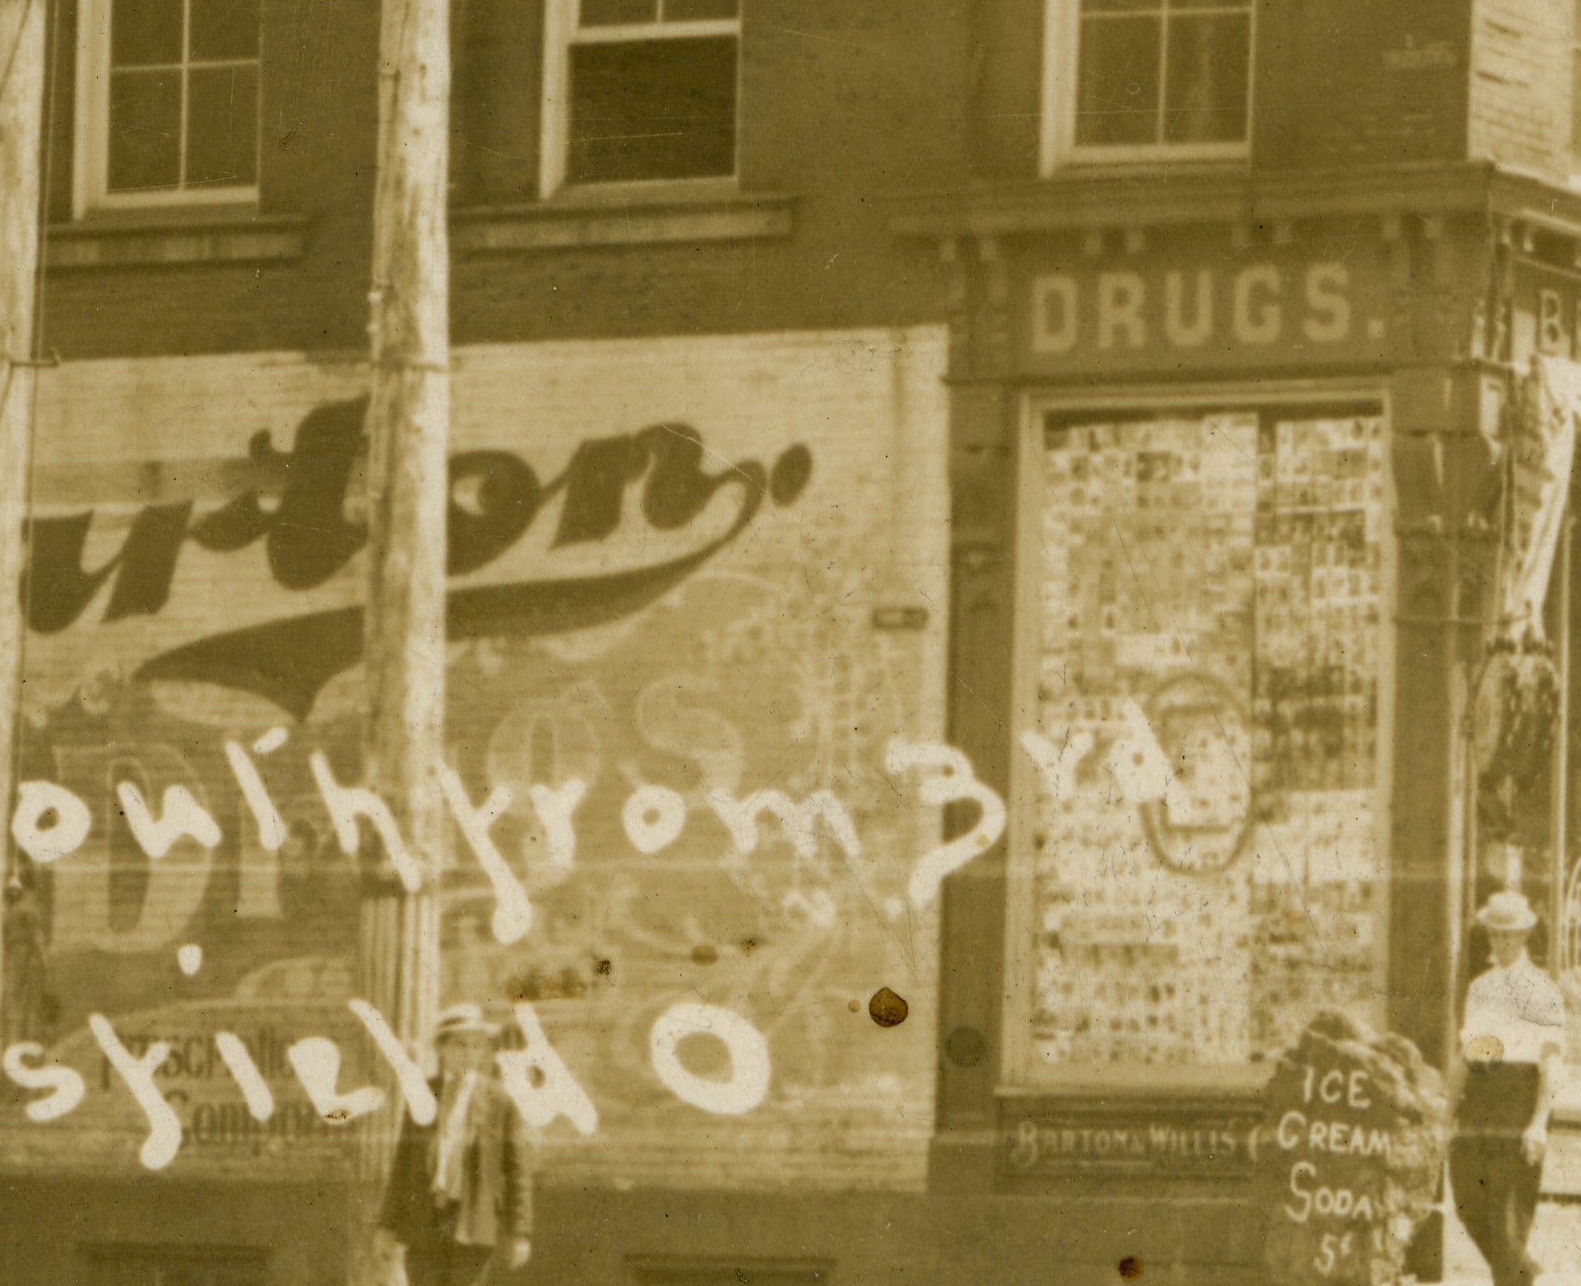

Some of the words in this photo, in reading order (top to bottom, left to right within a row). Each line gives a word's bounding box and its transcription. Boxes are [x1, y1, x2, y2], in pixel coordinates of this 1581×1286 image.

[1302, 1066, 1372, 1110] ICE
[1149, 1123, 1236, 1156] WILLIS
[1277, 1111, 1391, 1160] CREAM
[1284, 1160, 1375, 1225] SODA
